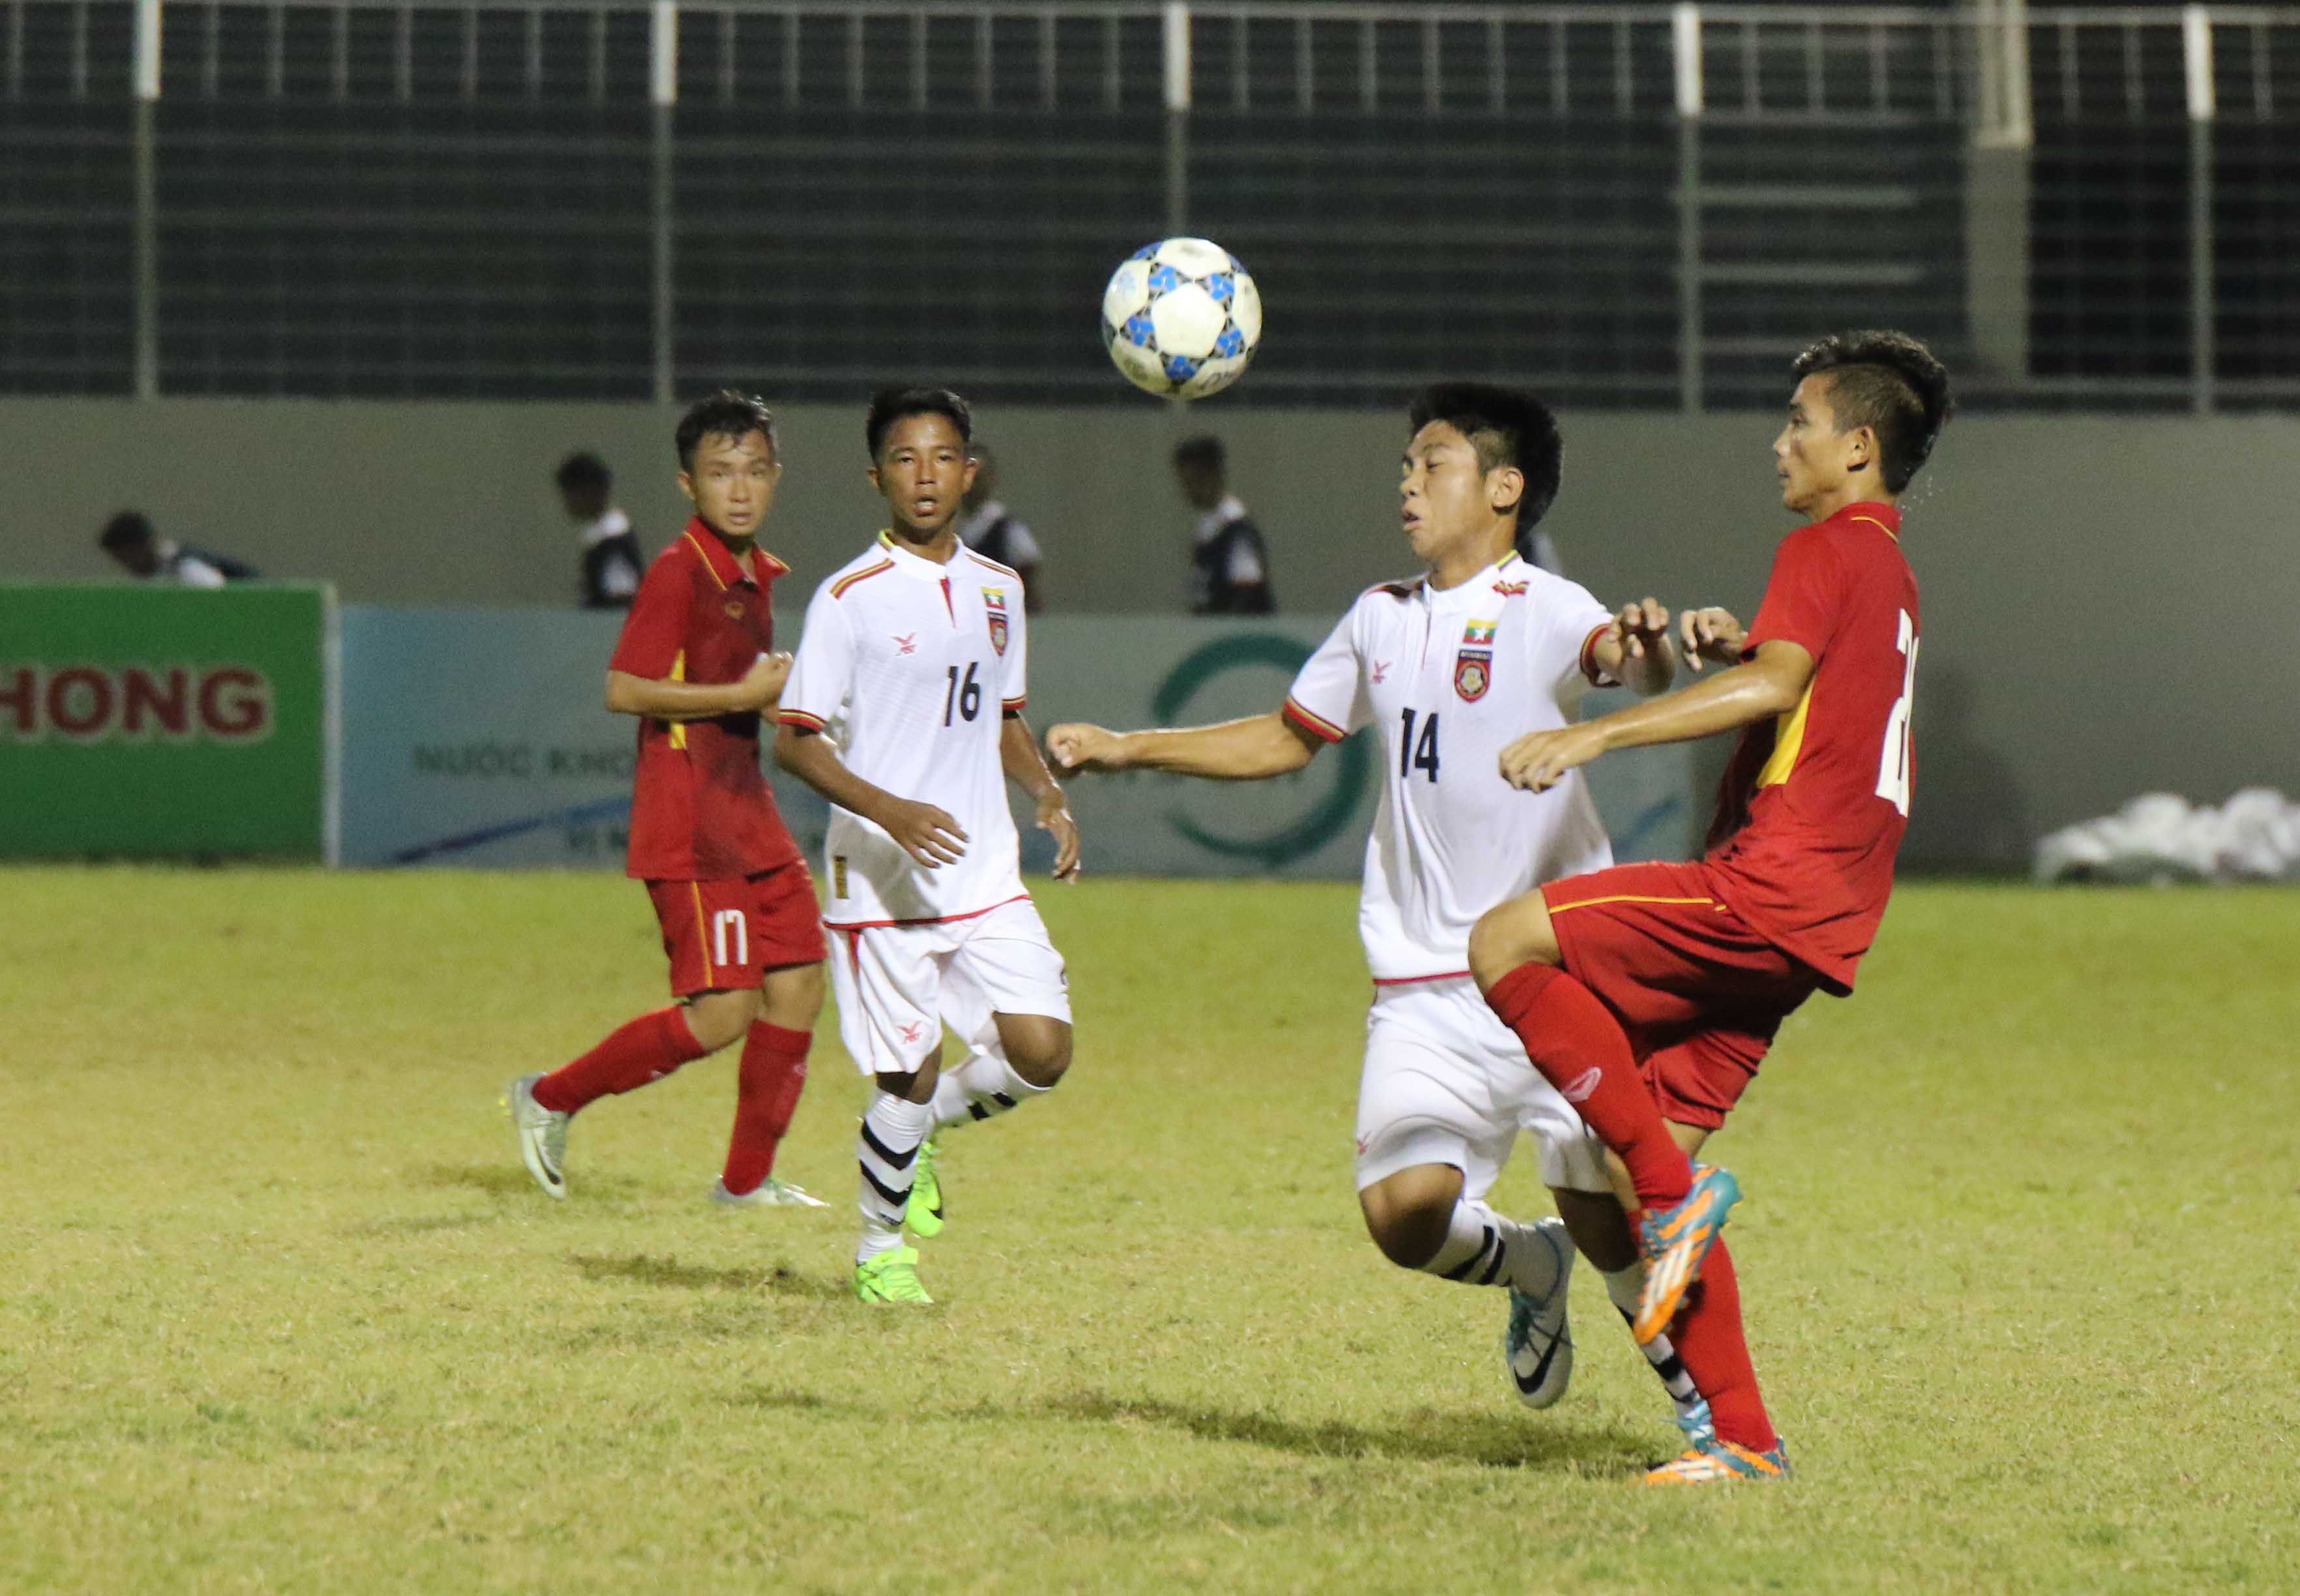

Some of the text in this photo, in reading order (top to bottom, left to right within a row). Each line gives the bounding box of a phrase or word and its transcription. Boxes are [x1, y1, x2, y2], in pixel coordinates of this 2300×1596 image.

[0, 666, 269, 737] HONG
[944, 661, 980, 728] 16
[1401, 707, 1439, 783] 14
[714, 909, 748, 966] 17
